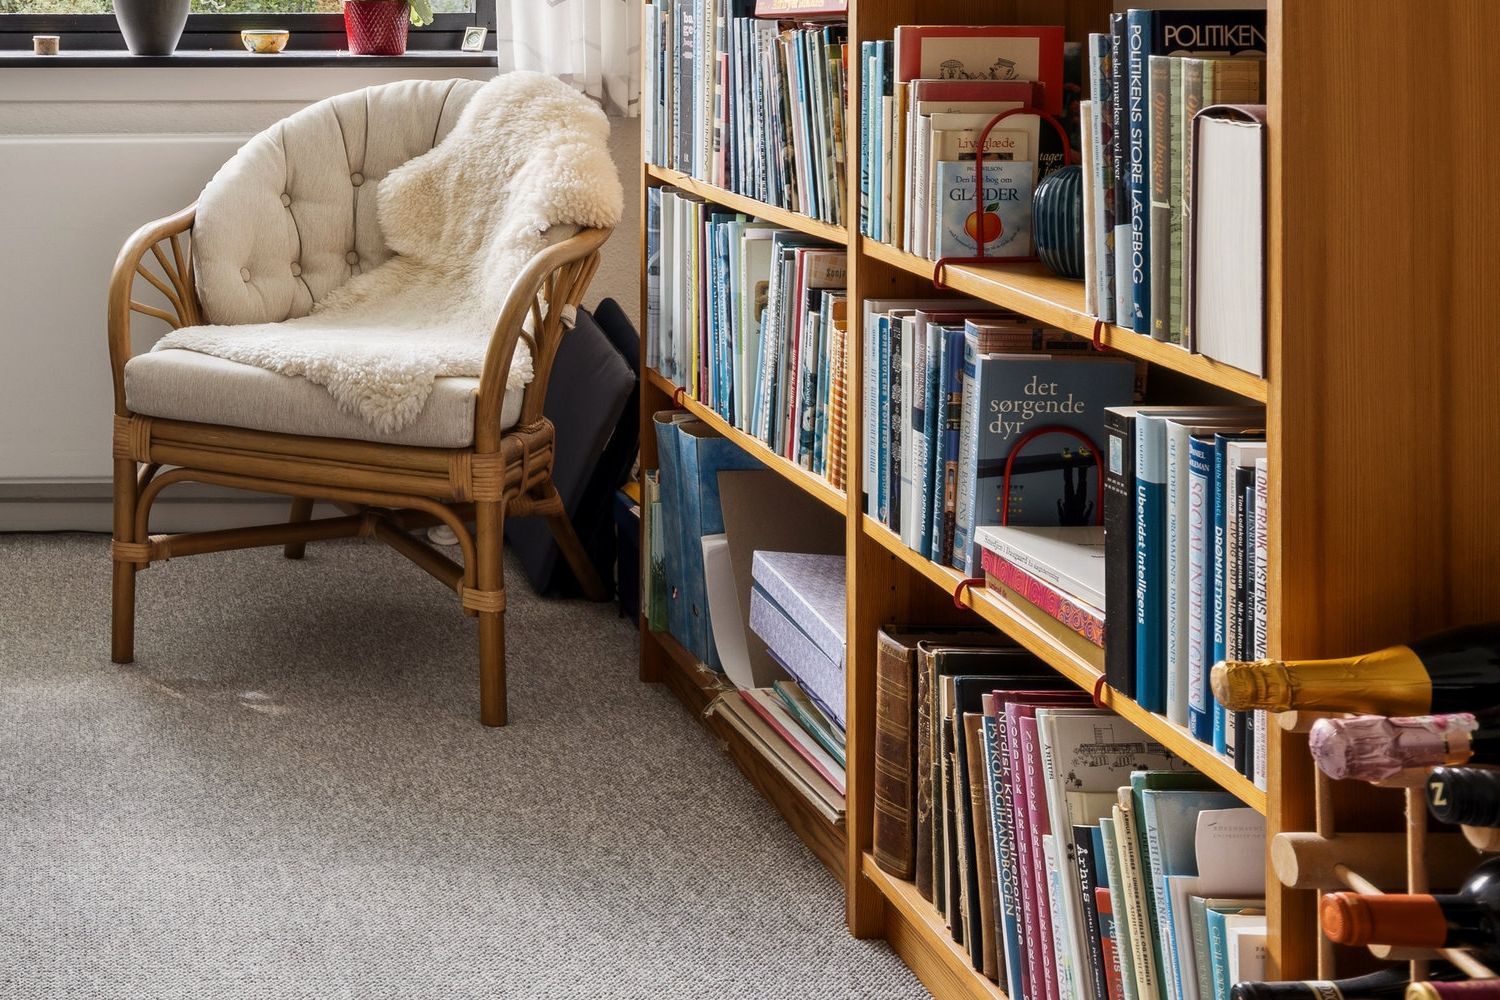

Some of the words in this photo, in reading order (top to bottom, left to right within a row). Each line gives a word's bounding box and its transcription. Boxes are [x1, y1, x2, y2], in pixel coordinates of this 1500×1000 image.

[1112, 35, 1121, 55] Det
[1112, 57, 1121, 78] skal
[1130, 24, 1143, 122] POLITIKENS
[1112, 81, 1122, 125] mærkes
[957, 137, 1015, 152] Livglæde
[1113, 128, 1121, 140] at
[1113, 141, 1122, 153] vi
[1152, 92, 1167, 195] Operabogen
[1113, 154, 1122, 181] lever
[1131, 127, 1143, 184] STORE
[955, 175, 970, 184] Den
[986, 174, 1000, 186] bog
[1150, 198, 1171, 209] 1
[1131, 189, 1144, 284] LÆGEBOG
[918, 343, 926, 362] DET
[918, 364, 926, 384] SKER
[1023, 375, 1059, 396] det
[965, 382, 974, 416] LIVET
[989, 393, 1086, 420] sørgende
[962, 419, 972, 467] FORSTÅS
[988, 413, 1025, 440] dyr
[969, 472, 977, 496] Svend
[1257, 467, 1267, 502] LONE
[1137, 485, 1147, 548] Ubevidst
[1190, 480, 1203, 557] SOCIAL
[1229, 520, 1237, 540] LIV
[1257, 505, 1267, 551] FRANK
[1169, 513, 1177, 585] DRØMMENES
[1229, 541, 1237, 556] OG
[1214, 525, 1223, 644] DRØMMETYDNING
[1229, 560, 1237, 582] DØD
[1236, 548, 1244, 589] Jørgensen
[1257, 554, 1267, 616] LYSTENS
[1136, 550, 1147, 625] intelligens
[1169, 587, 1177, 664] DIMENSIONER
[1237, 601, 1245, 617] Når
[1190, 561, 1203, 704] INTELLIGENS
[998, 710, 1012, 777] Nordisk
[1010, 715, 1023, 795] NORDISK
[1043, 743, 1055, 781] ÅRHUS
[1025, 730, 1038, 812] NORDISK
[1430, 781, 1447, 808] Z
[987, 722, 1015, 918] PSYKOLOGIHANDBOGEN
[1003, 782, 1024, 946] Kriminalreportage
[1126, 841, 1136, 871] BILLEDER
[1147, 824, 1162, 877] ÅRHUS
[1076, 843, 1092, 904] Århus
[1131, 877, 1140, 899] UNDER
[1135, 900, 1146, 940] BESÆTTELSE
[1107, 919, 1122, 973] Aarhus
[1140, 941, 1148, 952] OG
[1212, 926, 1223, 962] CECIL
[1142, 953, 1152, 987] BEFRIELSE
